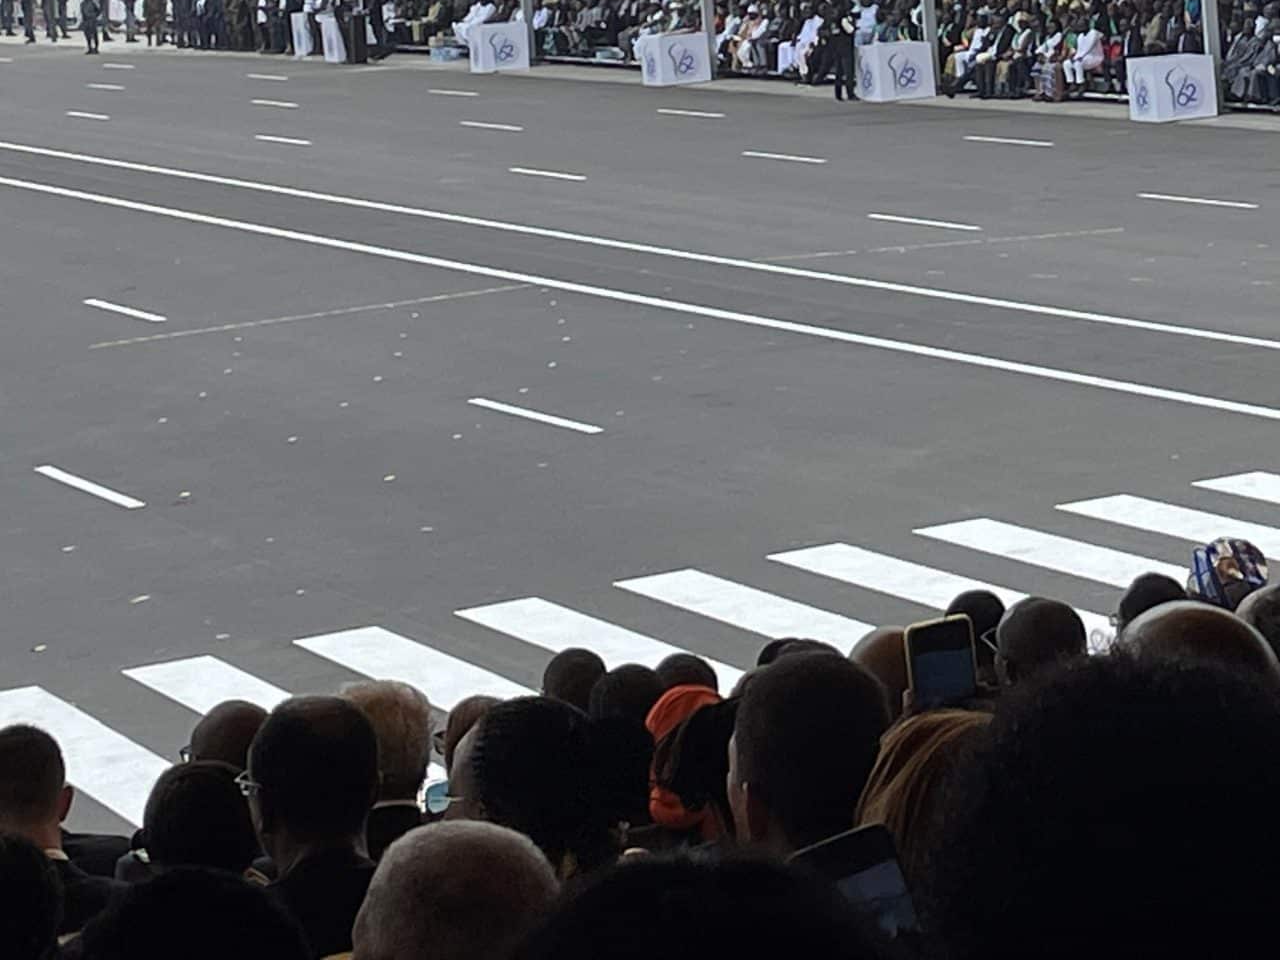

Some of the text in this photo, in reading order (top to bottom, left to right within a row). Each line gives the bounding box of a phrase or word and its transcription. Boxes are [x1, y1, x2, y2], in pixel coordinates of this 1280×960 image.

[679, 50, 695, 74] 62
[899, 61, 917, 87] 62
[1177, 76, 1197, 107] 62
